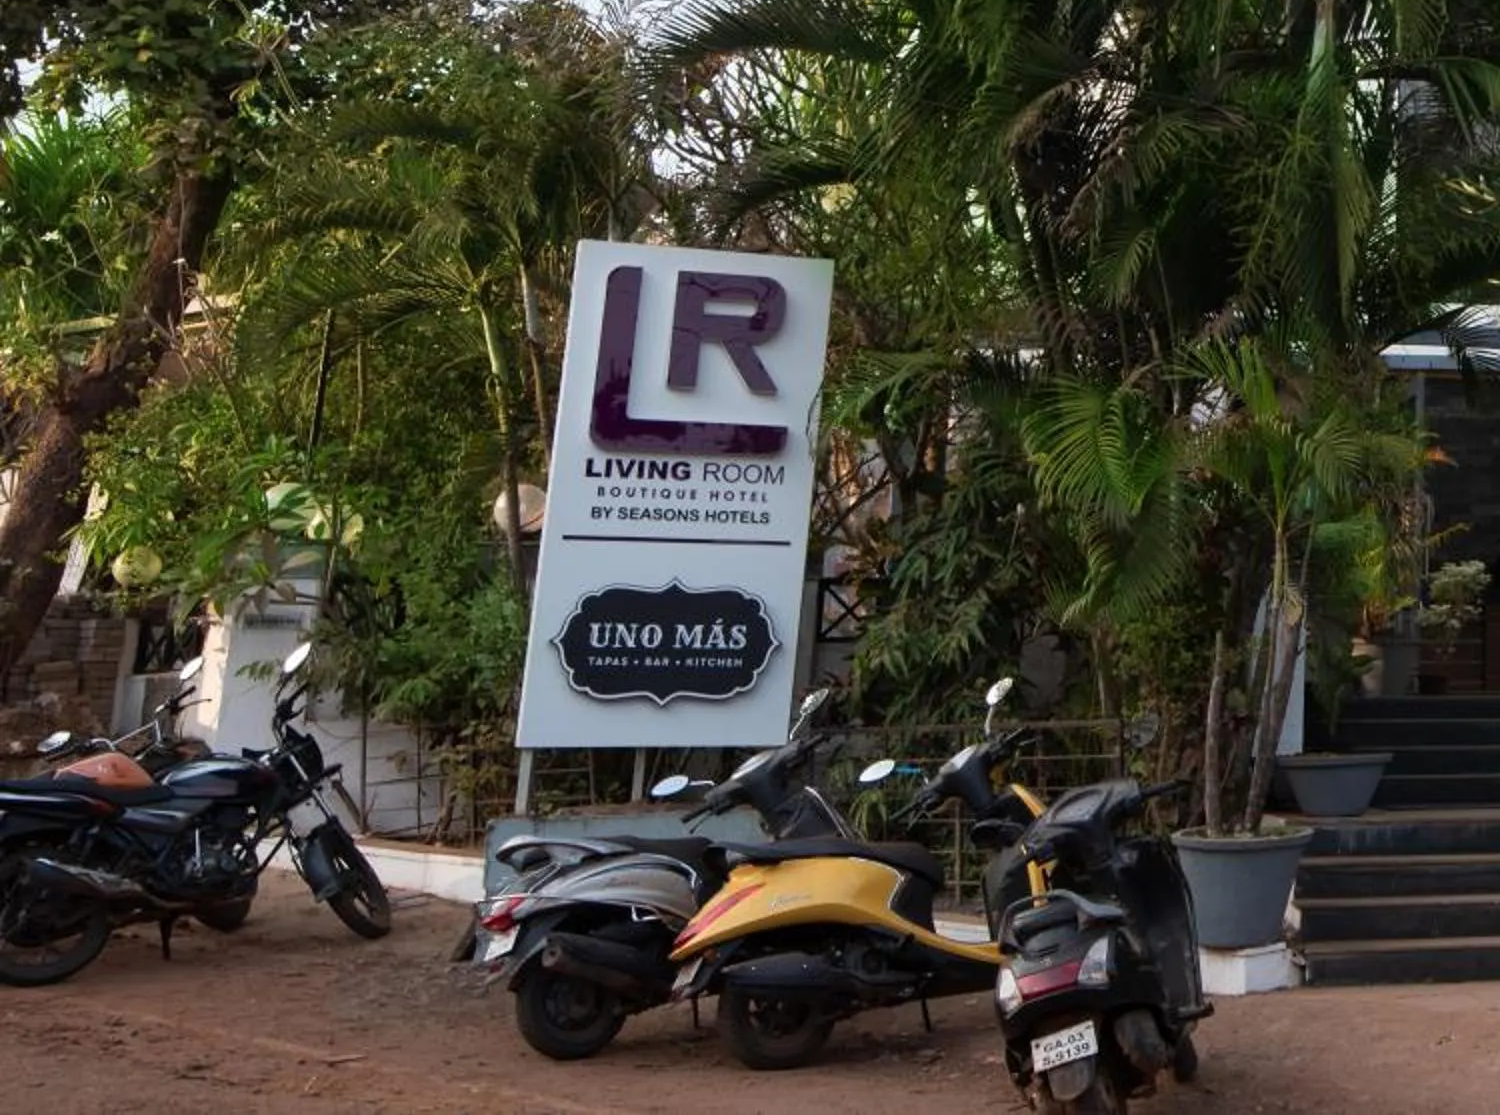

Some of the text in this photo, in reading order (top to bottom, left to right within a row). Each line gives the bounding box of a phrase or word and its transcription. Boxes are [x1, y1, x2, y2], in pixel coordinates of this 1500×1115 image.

[585, 457, 785, 485] LIVING ROOM
[597, 486, 769, 503] BOUTIQUE HOTEL
[591, 506, 771, 525] BY SEASONS HOTELS
[588, 618, 748, 650] UNO MÁS
[587, 656, 744, 668] TAPAS BAR KITCHEN
